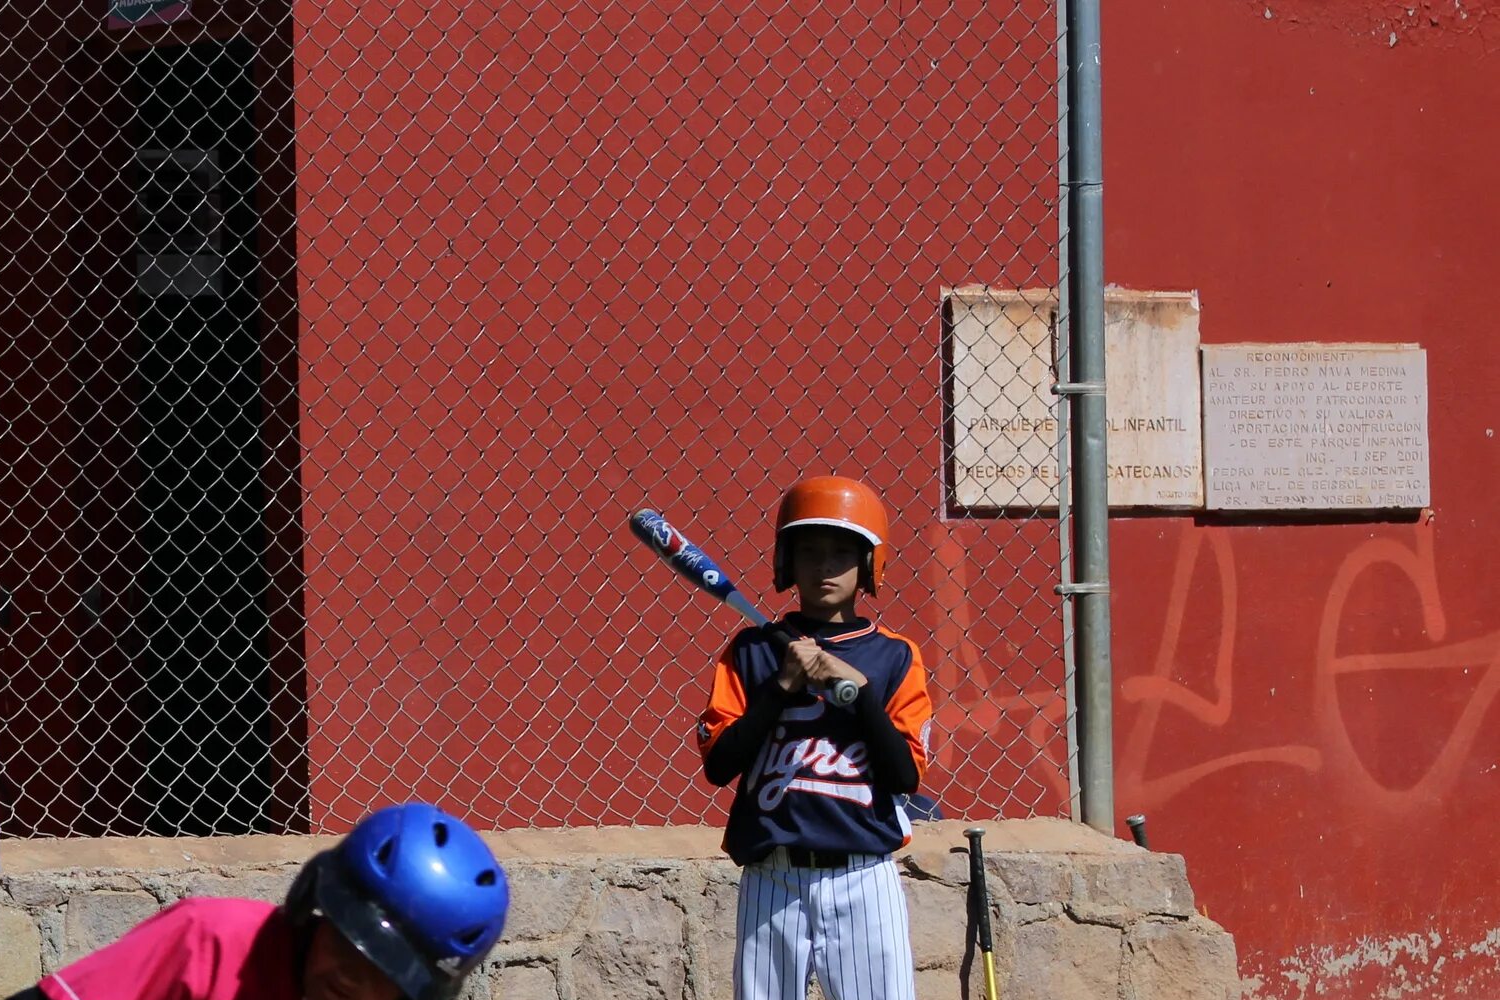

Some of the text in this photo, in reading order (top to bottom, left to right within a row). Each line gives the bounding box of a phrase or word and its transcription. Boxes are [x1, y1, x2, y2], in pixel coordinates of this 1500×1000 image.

[1246, 352, 1354, 362] RECONOCIMIENTO
[1209, 367, 1224, 377] AL
[1233, 367, 1255, 377] SR.
[1265, 367, 1309, 377] PEDRO
[1360, 366, 1406, 377] MEDINA
[1210, 382, 1236, 391] POR
[1250, 382, 1267, 391] SU
[1274, 382, 1315, 391] APOYO
[1346, 381, 1403, 391] DEPORTE
[1210, 396, 1271, 405] AMATEUR
[1275, 396, 1306, 405] COMO
[1316, 395, 1412, 405] PATROCINADOR
[1229, 409, 1292, 419] DIRECTIVO
[1316, 410, 1330, 419] SU
[1339, 409, 1394, 419] VALIOSA
[970, 417, 1054, 432] PARQUE DE
[1123, 417, 1187, 432] INFANTIL
[1241, 438, 1423, 449] DE ESTE PARQUE INFANTIL
[1364, 451, 1387, 462] SEP
[1397, 451, 1424, 462] 2001
[1213, 467, 1254, 477] PEDRO
[1264, 466, 1290, 476] RUIZ
[1335, 465, 1414, 476] PRESIDENTE
[1288, 480, 1304, 490] DE
[1312, 480, 1363, 490] BEISBOL
[1371, 479, 1386, 489] DE
[1225, 496, 1248, 506] SR.
[1377, 494, 1423, 504] MEDINA
